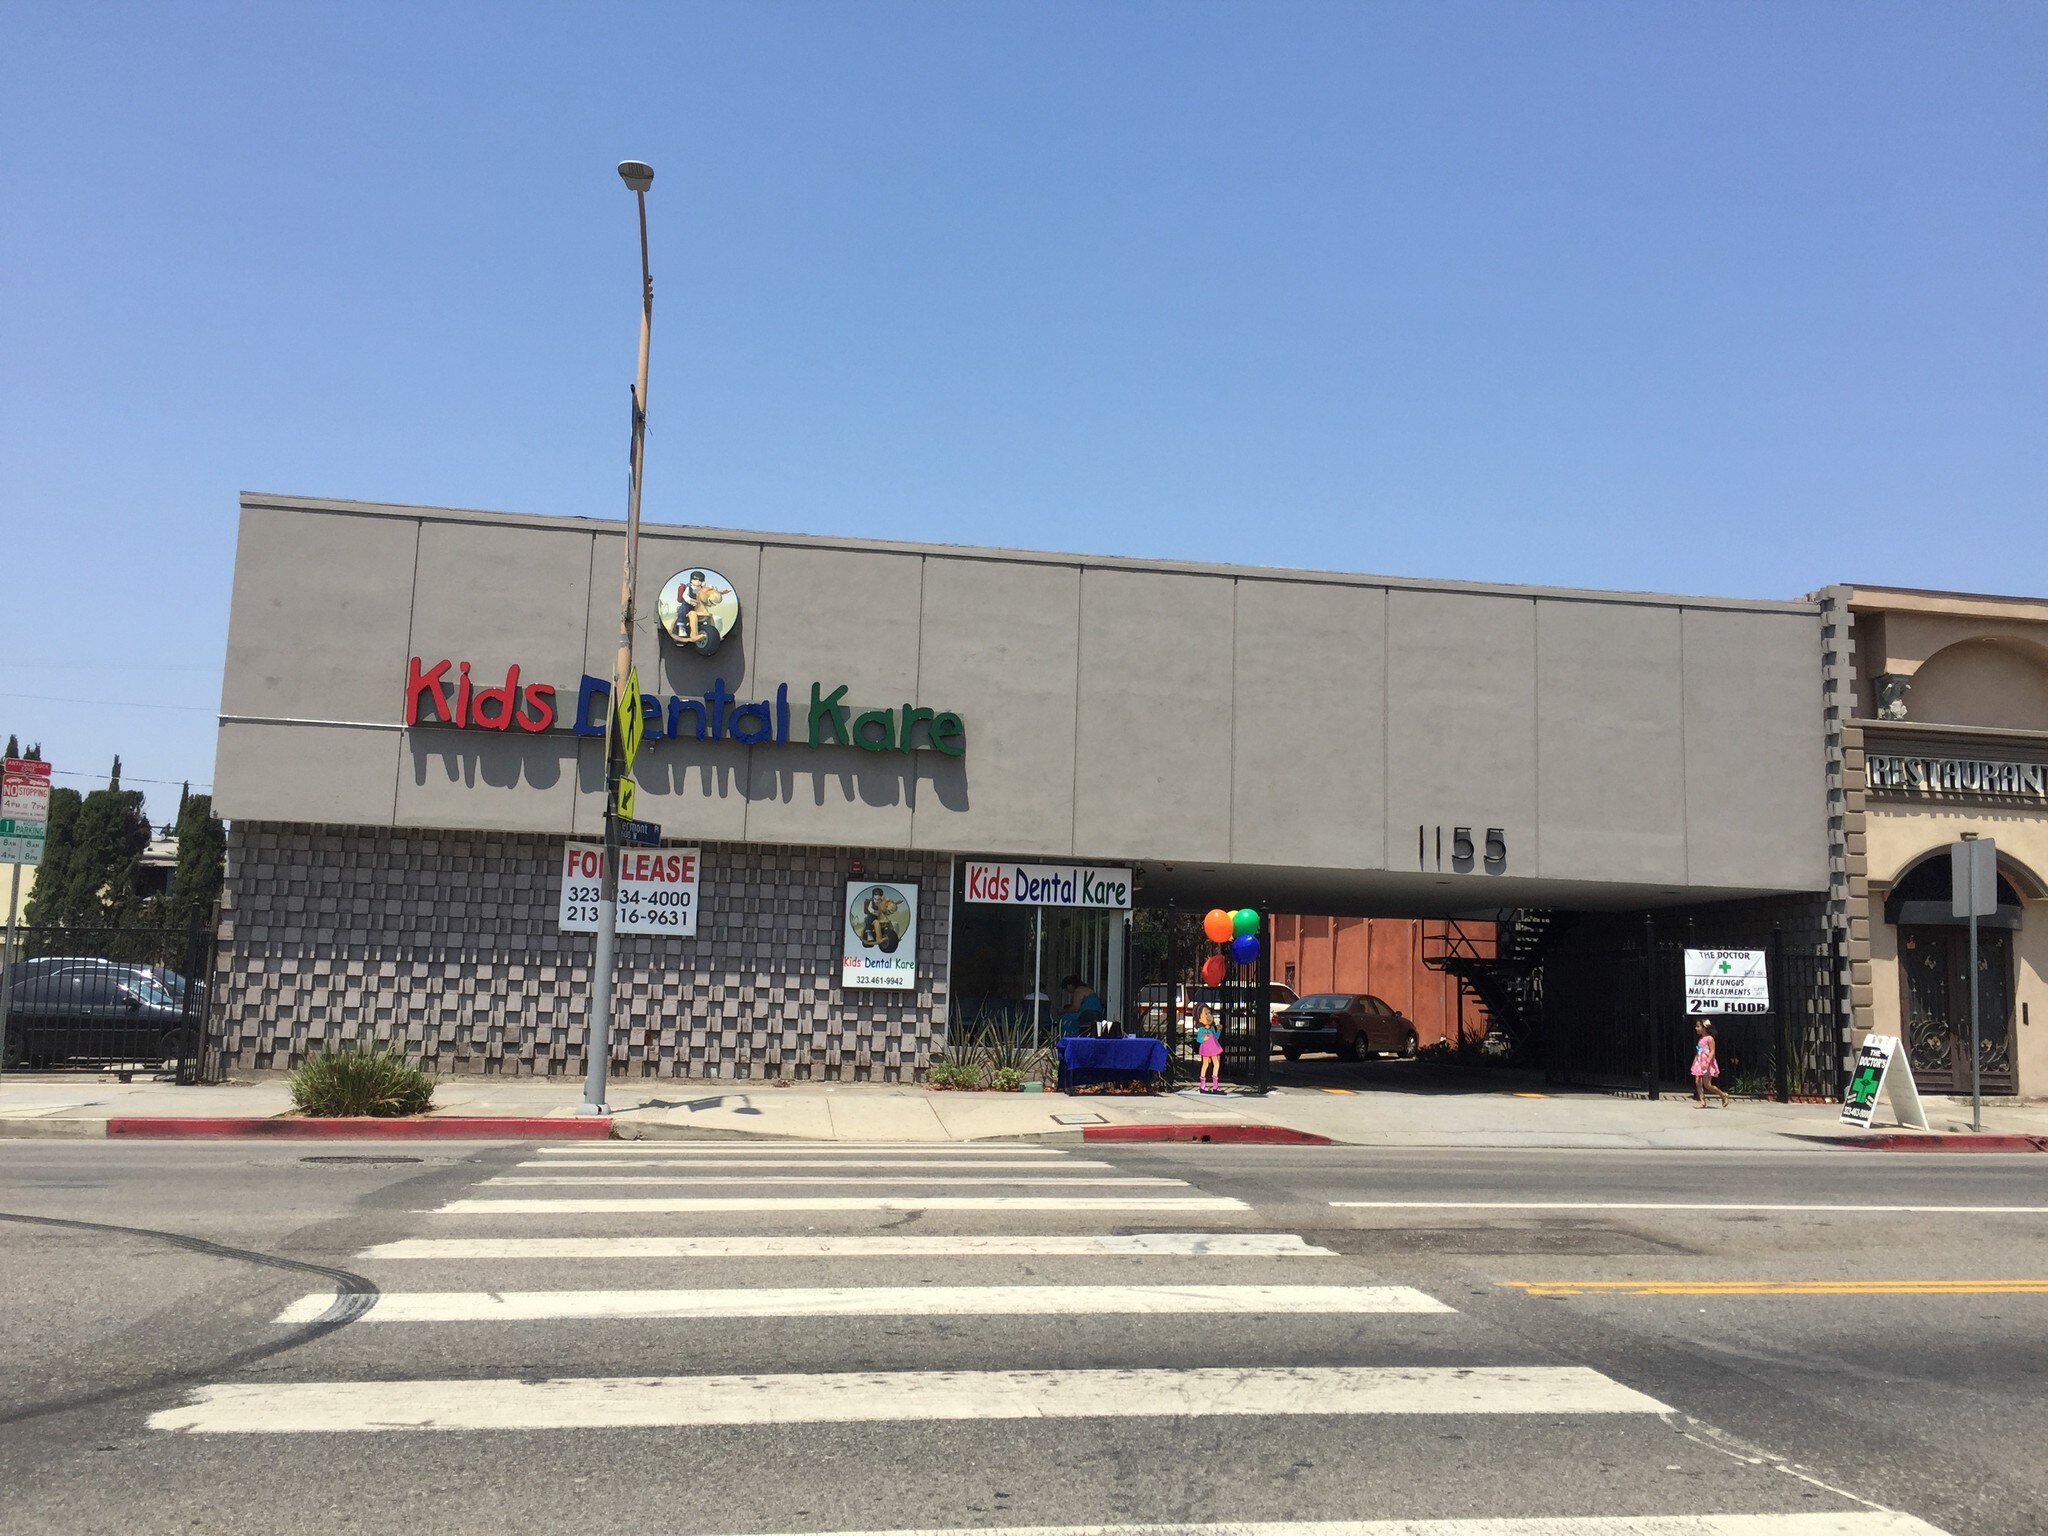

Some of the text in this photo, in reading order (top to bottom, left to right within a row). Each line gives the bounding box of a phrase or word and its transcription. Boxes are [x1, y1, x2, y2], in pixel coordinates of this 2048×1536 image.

[406, 657, 965, 756] Kids Dental Kare
[3, 785, 48, 798] NO STOPPING
[16, 825, 44, 836] PARKING
[1419, 825, 1506, 860] 1155
[621, 854, 696, 883] LEASE
[969, 865, 1126, 905] Kids Dental Kare
[568, 887, 691, 907] 323 34-4000
[567, 906, 687, 926] 213 16-9631
[1699, 951, 1751, 960] THE DOCTOR
[843, 956, 915, 970] Kids Dental Kare
[1694, 978, 1745, 987] LASER FUNGUS
[1707, 988, 1751, 996] TREATMENTS
[1690, 999, 1766, 1013] 2ND FLOOR
